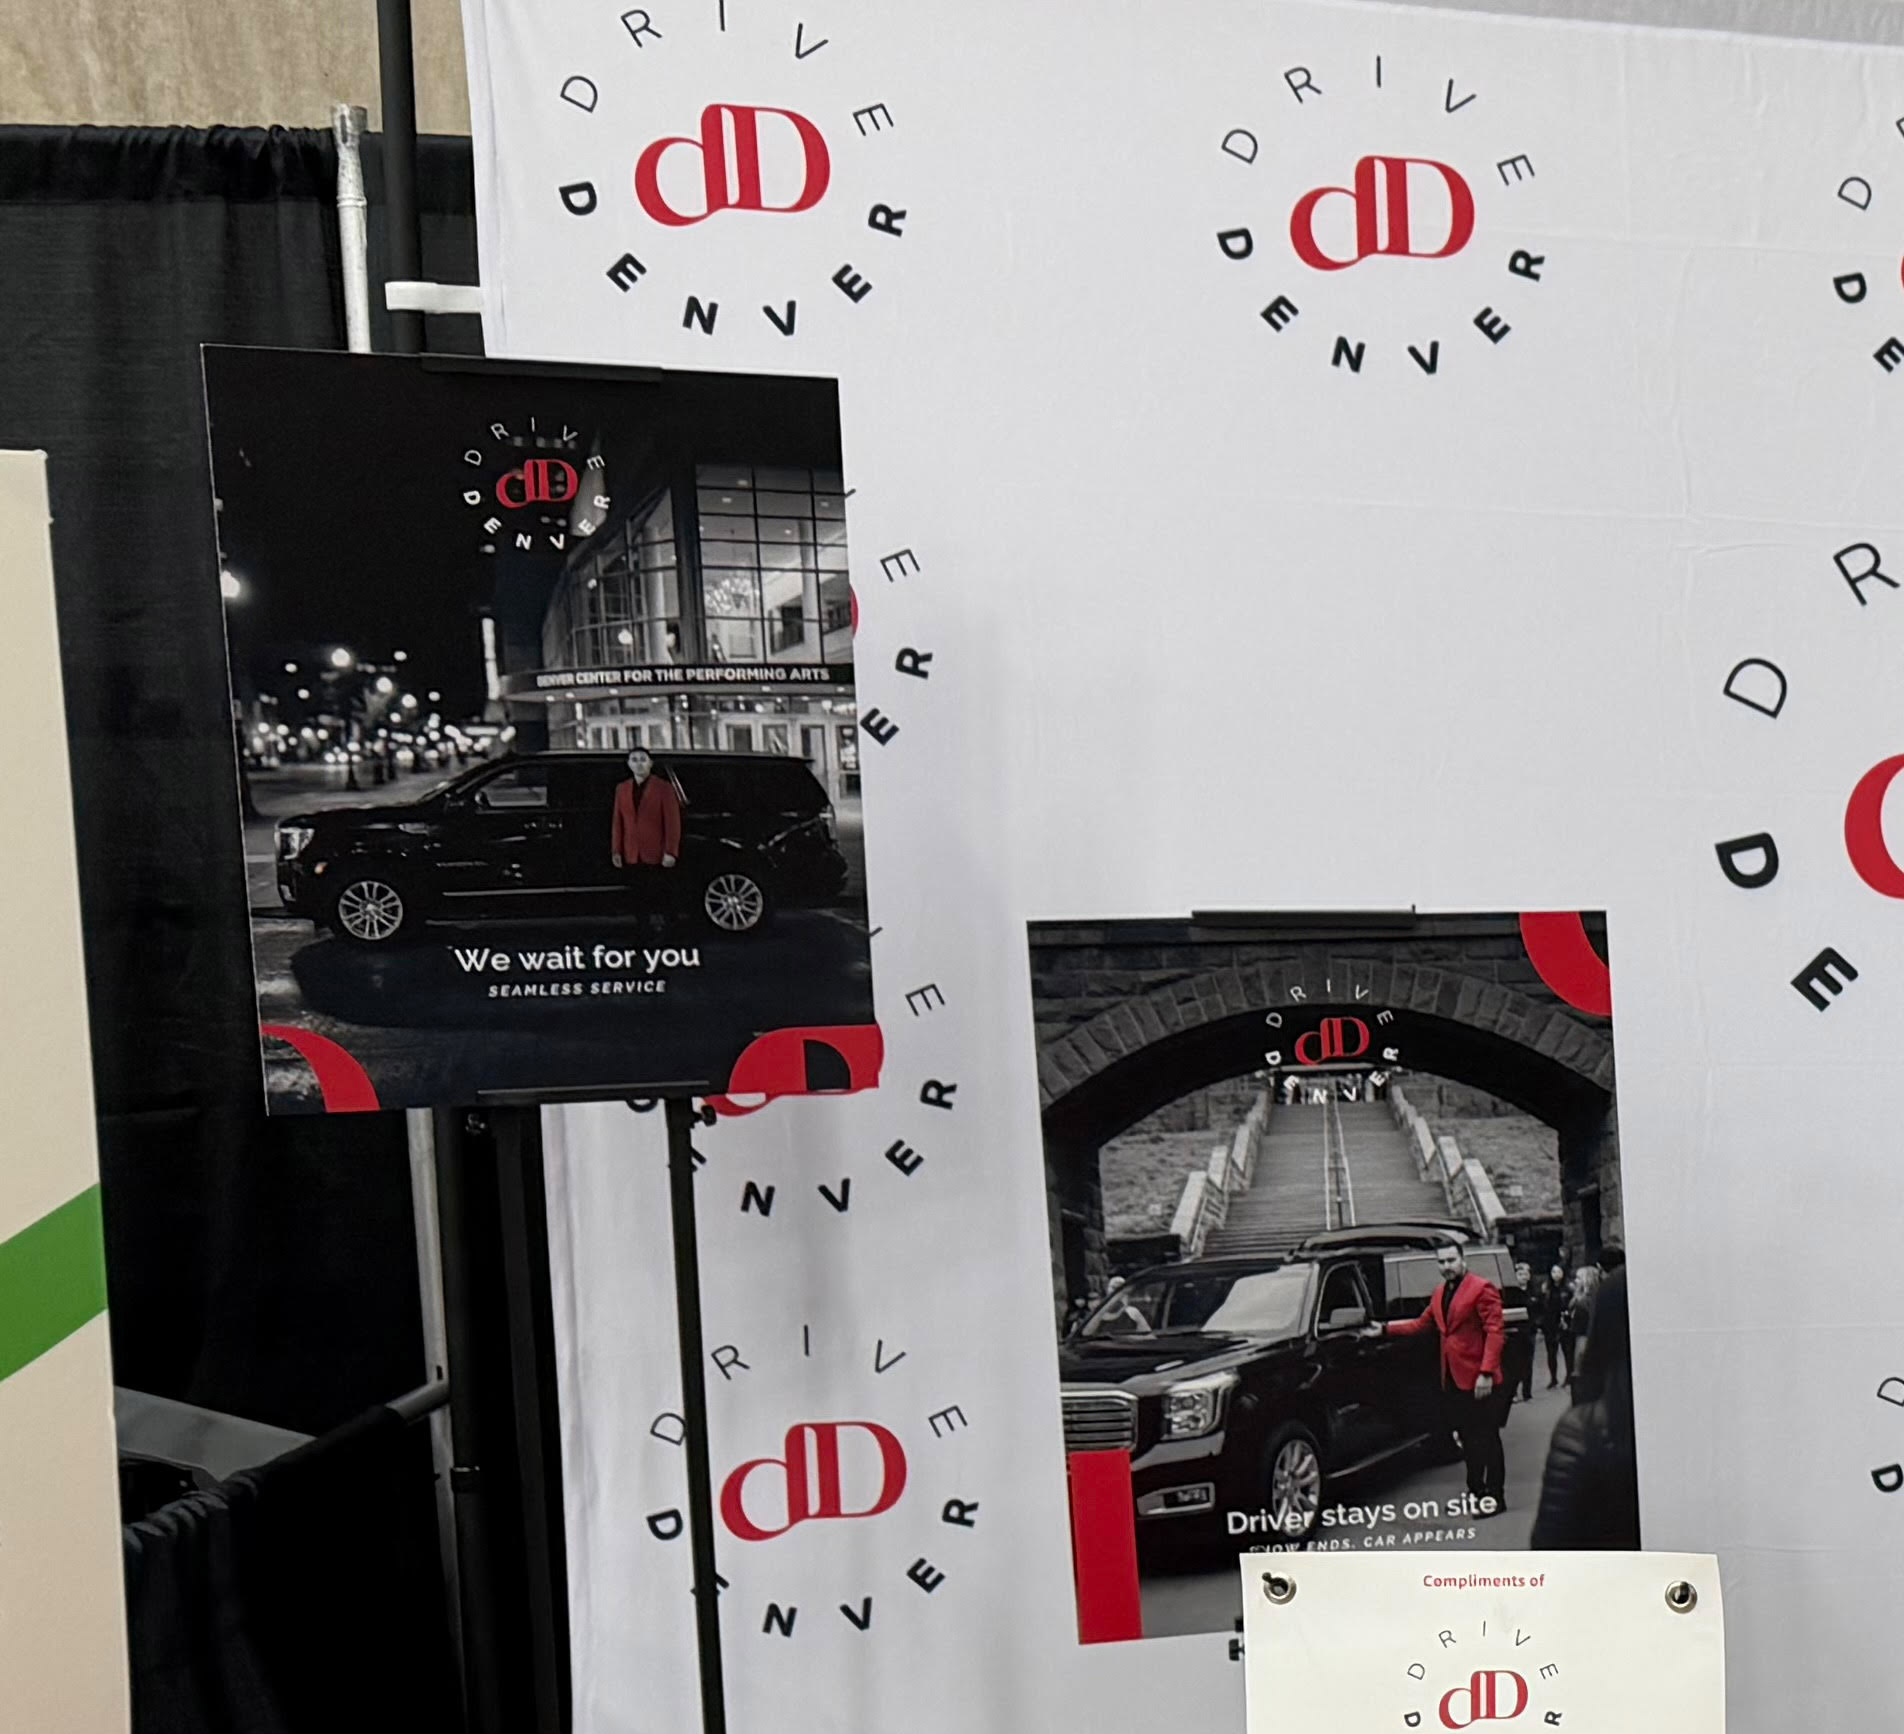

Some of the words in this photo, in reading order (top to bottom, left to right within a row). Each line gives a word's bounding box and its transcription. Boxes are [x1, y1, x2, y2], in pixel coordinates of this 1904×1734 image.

[624, 668, 651, 683] FOR
[654, 668, 684, 682] THE
[686, 667, 786, 681] PERFORMING
[789, 668, 830, 681] ARTS
[454, 948, 511, 972] We
[518, 945, 586, 971] wait
[592, 944, 636, 969] for
[643, 948, 700, 974] you
[488, 982, 582, 998] SEAMLESS
[590, 980, 666, 995] SERVICE
[1227, 1508, 1315, 1535] Driver
[1322, 1502, 1396, 1529] stays
[1403, 1501, 1439, 1520] on
[1447, 1492, 1497, 1517] site
[1364, 1534, 1396, 1547] CAR
[1403, 1528, 1475, 1544] APPEARS
[1424, 1575, 1525, 1589] Compliments
[1530, 1574, 1544, 1586] of
